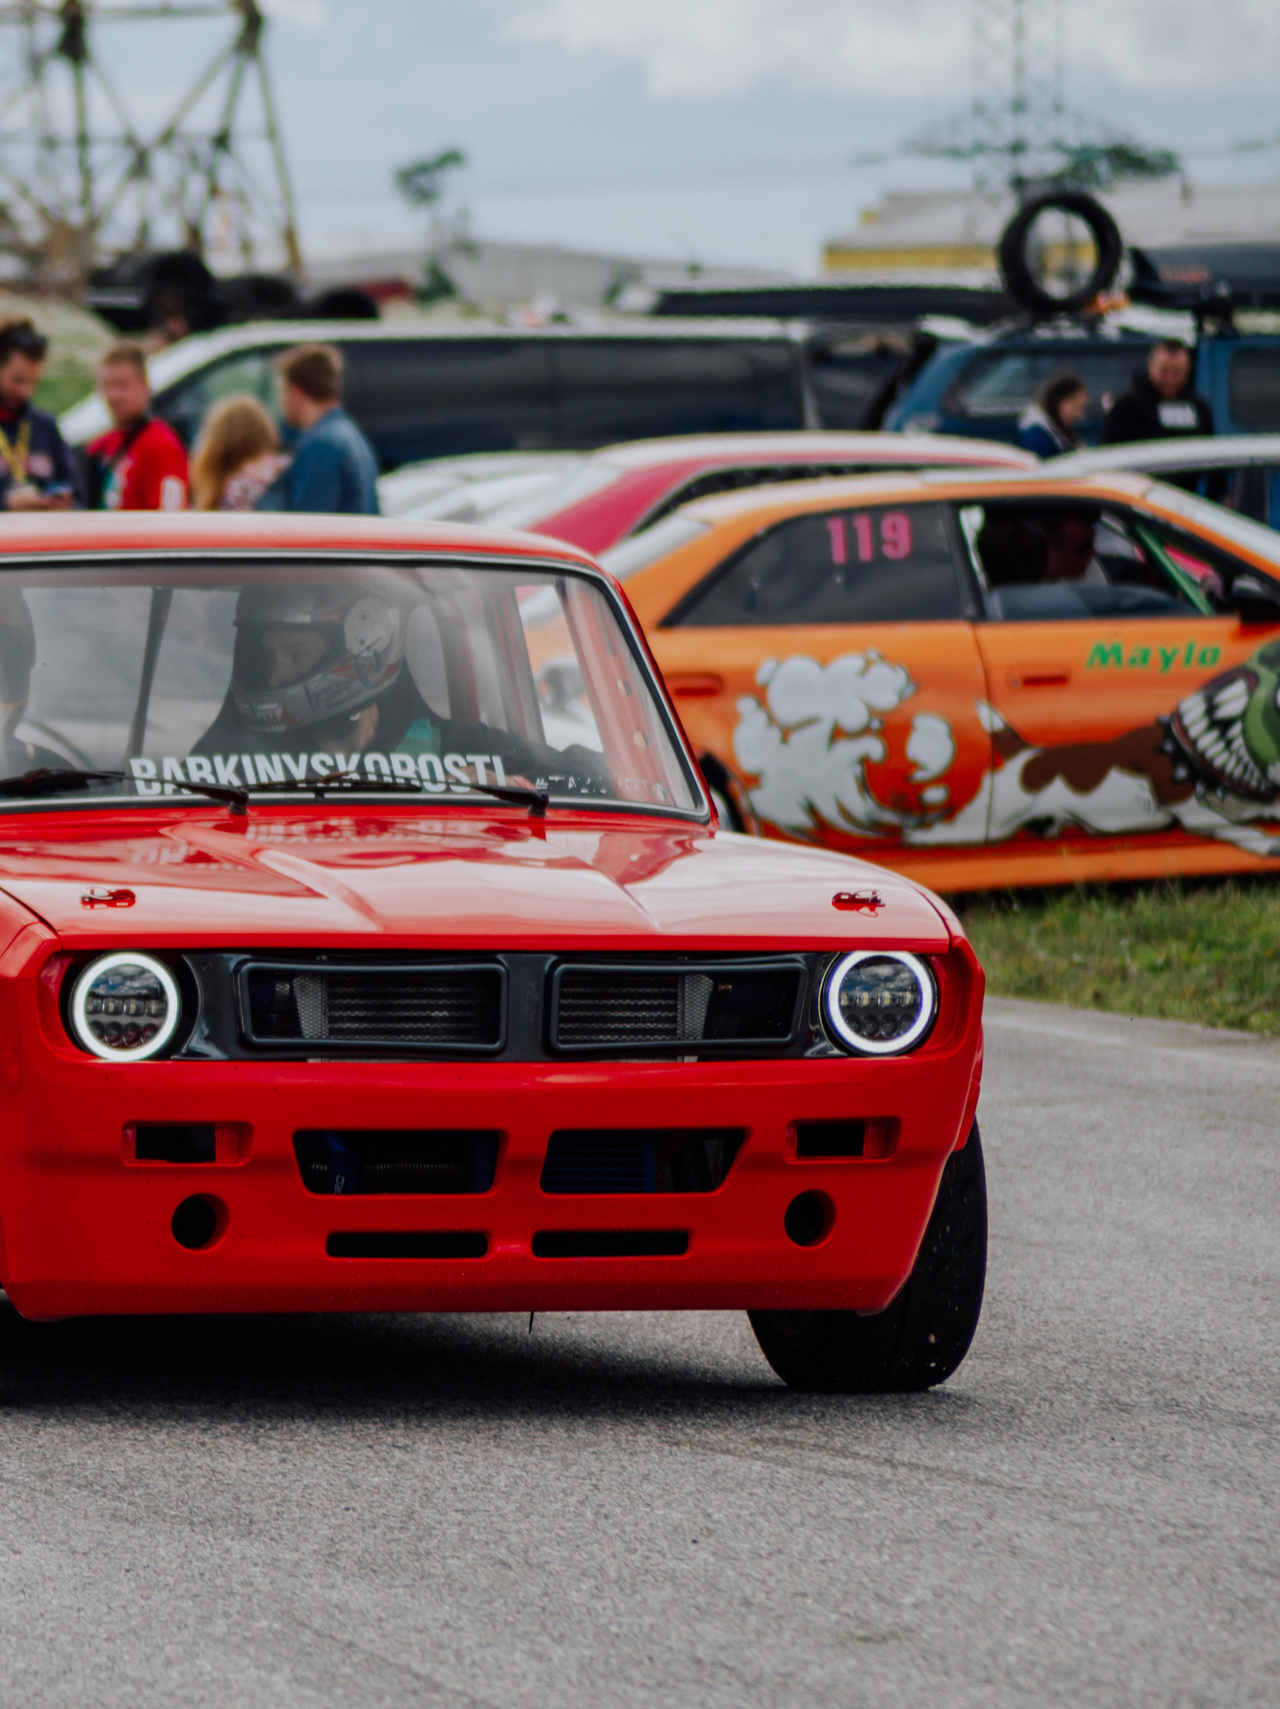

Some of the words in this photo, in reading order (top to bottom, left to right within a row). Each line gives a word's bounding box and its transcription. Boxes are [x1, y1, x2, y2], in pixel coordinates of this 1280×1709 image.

[825, 512, 912, 565] 119
[1086, 639, 1221, 675] Maylo
[129, 752, 507, 796] BARKINYSKOROSTI
